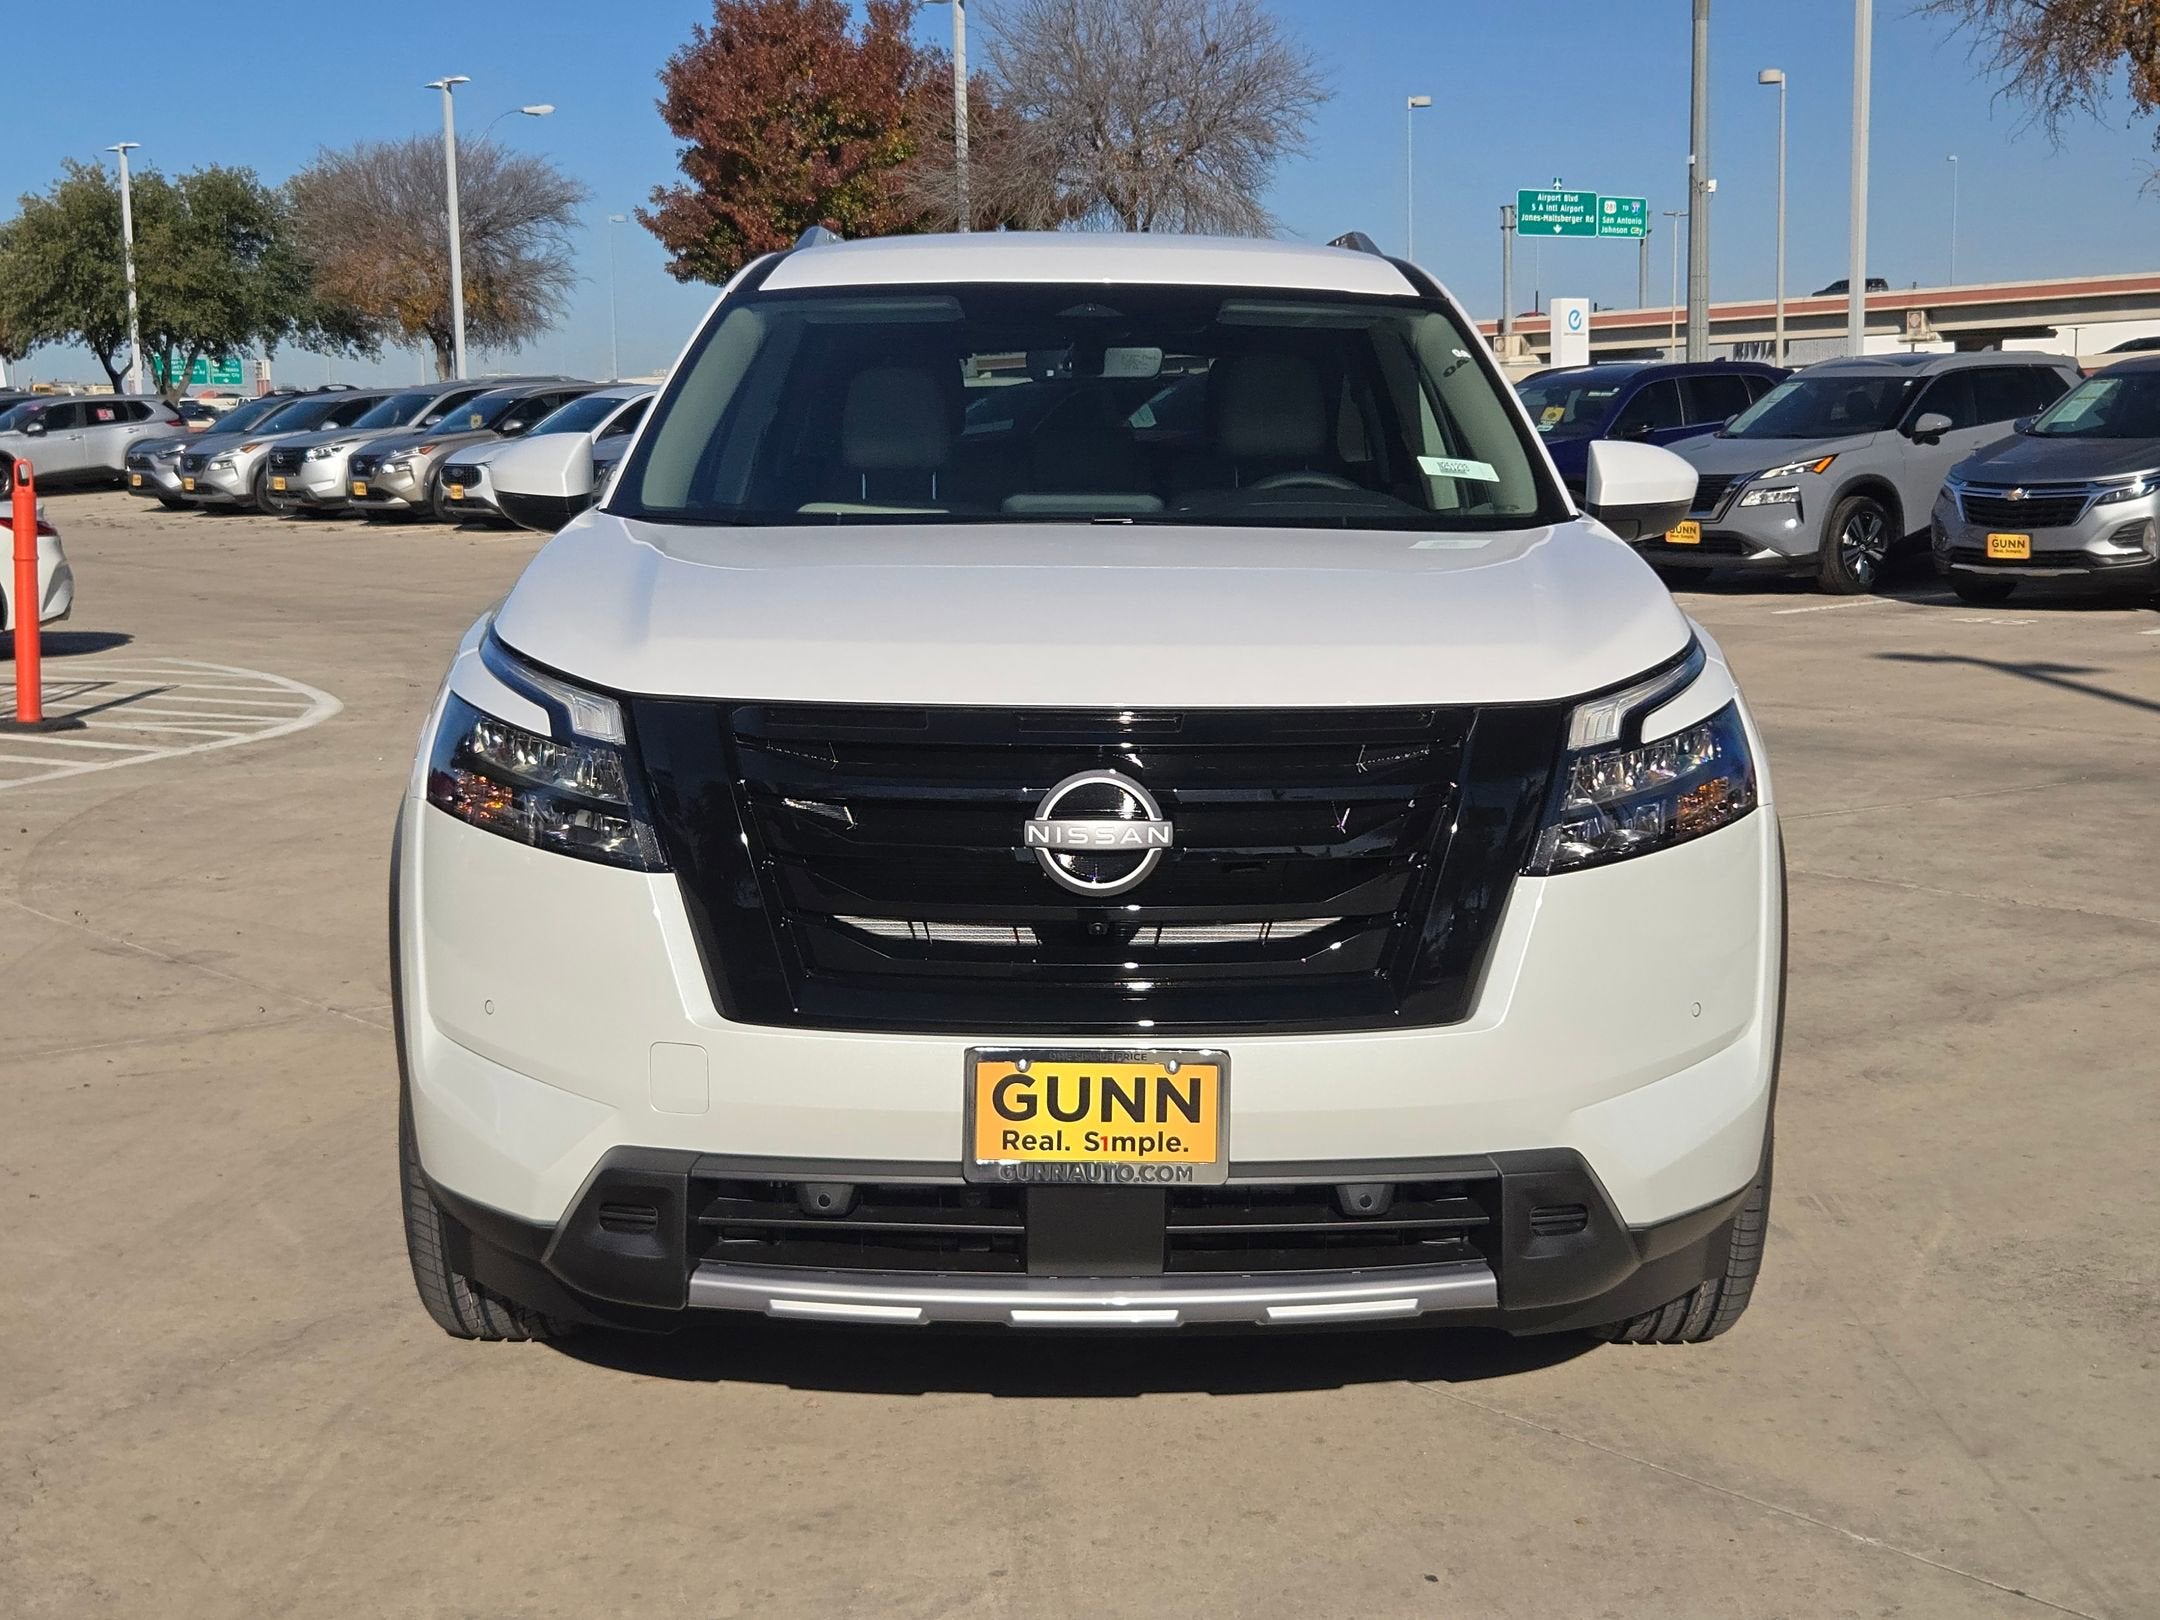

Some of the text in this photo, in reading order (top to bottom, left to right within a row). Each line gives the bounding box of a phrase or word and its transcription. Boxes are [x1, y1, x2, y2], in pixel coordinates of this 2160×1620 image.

[1537, 193, 1579, 203] Airport Blvd
[1531, 203, 1584, 213] S A Intl Airport
[1521, 213, 1594, 224] Jones-Maltsberger Rd
[1616, 217, 1642, 225] Antonio
[1601, 226, 1628, 234] Johnson
[1992, 539, 2025, 548] GUNN
[1028, 825, 1169, 844] NISSAN
[1117, 1053, 1147, 1061] PRICE
[992, 1073, 1201, 1123] GUNN
[1002, 1130, 1071, 1151] Real.
[1000, 1164, 1193, 1183] GUNNAUTO.COM
